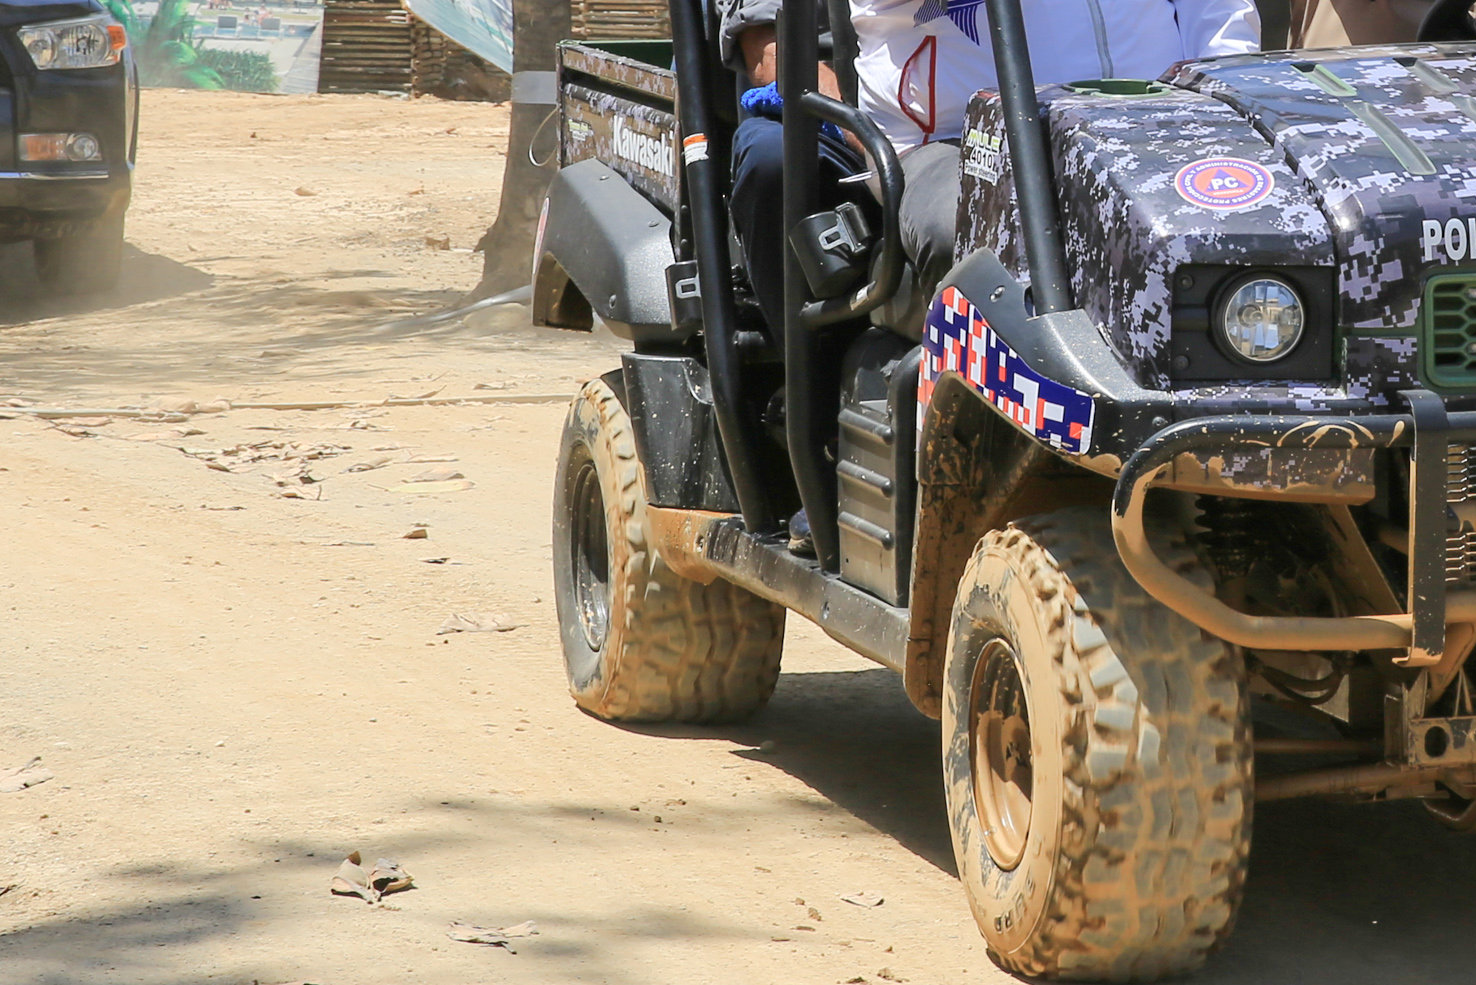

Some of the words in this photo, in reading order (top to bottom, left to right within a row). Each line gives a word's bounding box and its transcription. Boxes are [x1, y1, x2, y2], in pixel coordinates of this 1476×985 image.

[613, 115, 674, 177] Kawasaki
[966, 128, 1001, 155] MULE
[969, 147, 995, 170] 4010
[1211, 176, 1239, 190] PC
